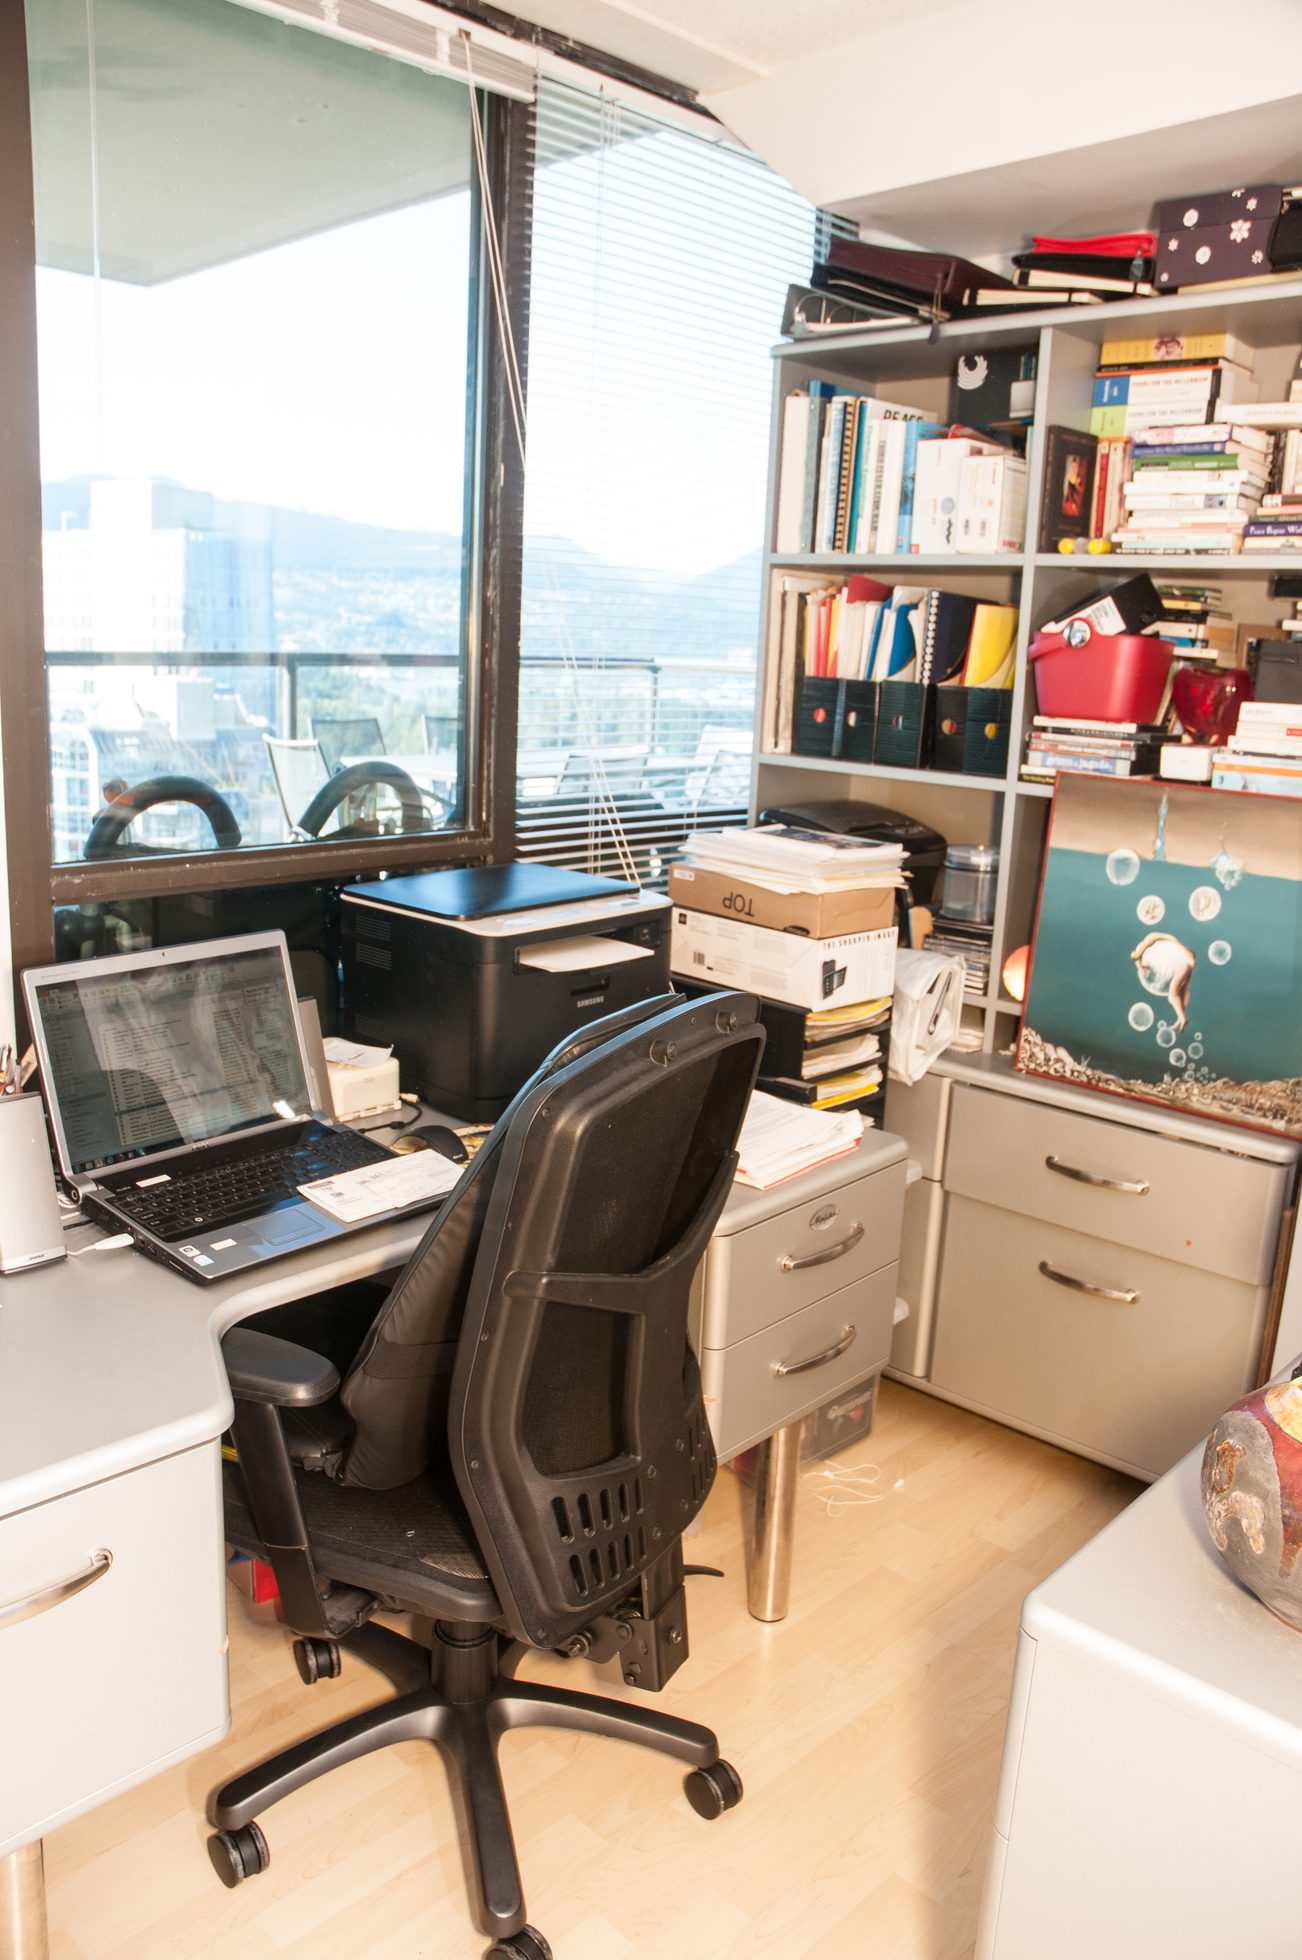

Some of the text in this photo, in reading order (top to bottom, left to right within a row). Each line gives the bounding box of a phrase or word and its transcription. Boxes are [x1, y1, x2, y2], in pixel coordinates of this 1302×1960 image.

[1174, 376, 1208, 385] MILLENNIUM
[1169, 407, 1203, 416] MILLENNIUM
[722, 891, 755, 917] TOP
[838, 934, 871, 948] SHARPER
[874, 930, 896, 942] IMAGE
[576, 995, 605, 1009] SAMSUNG
